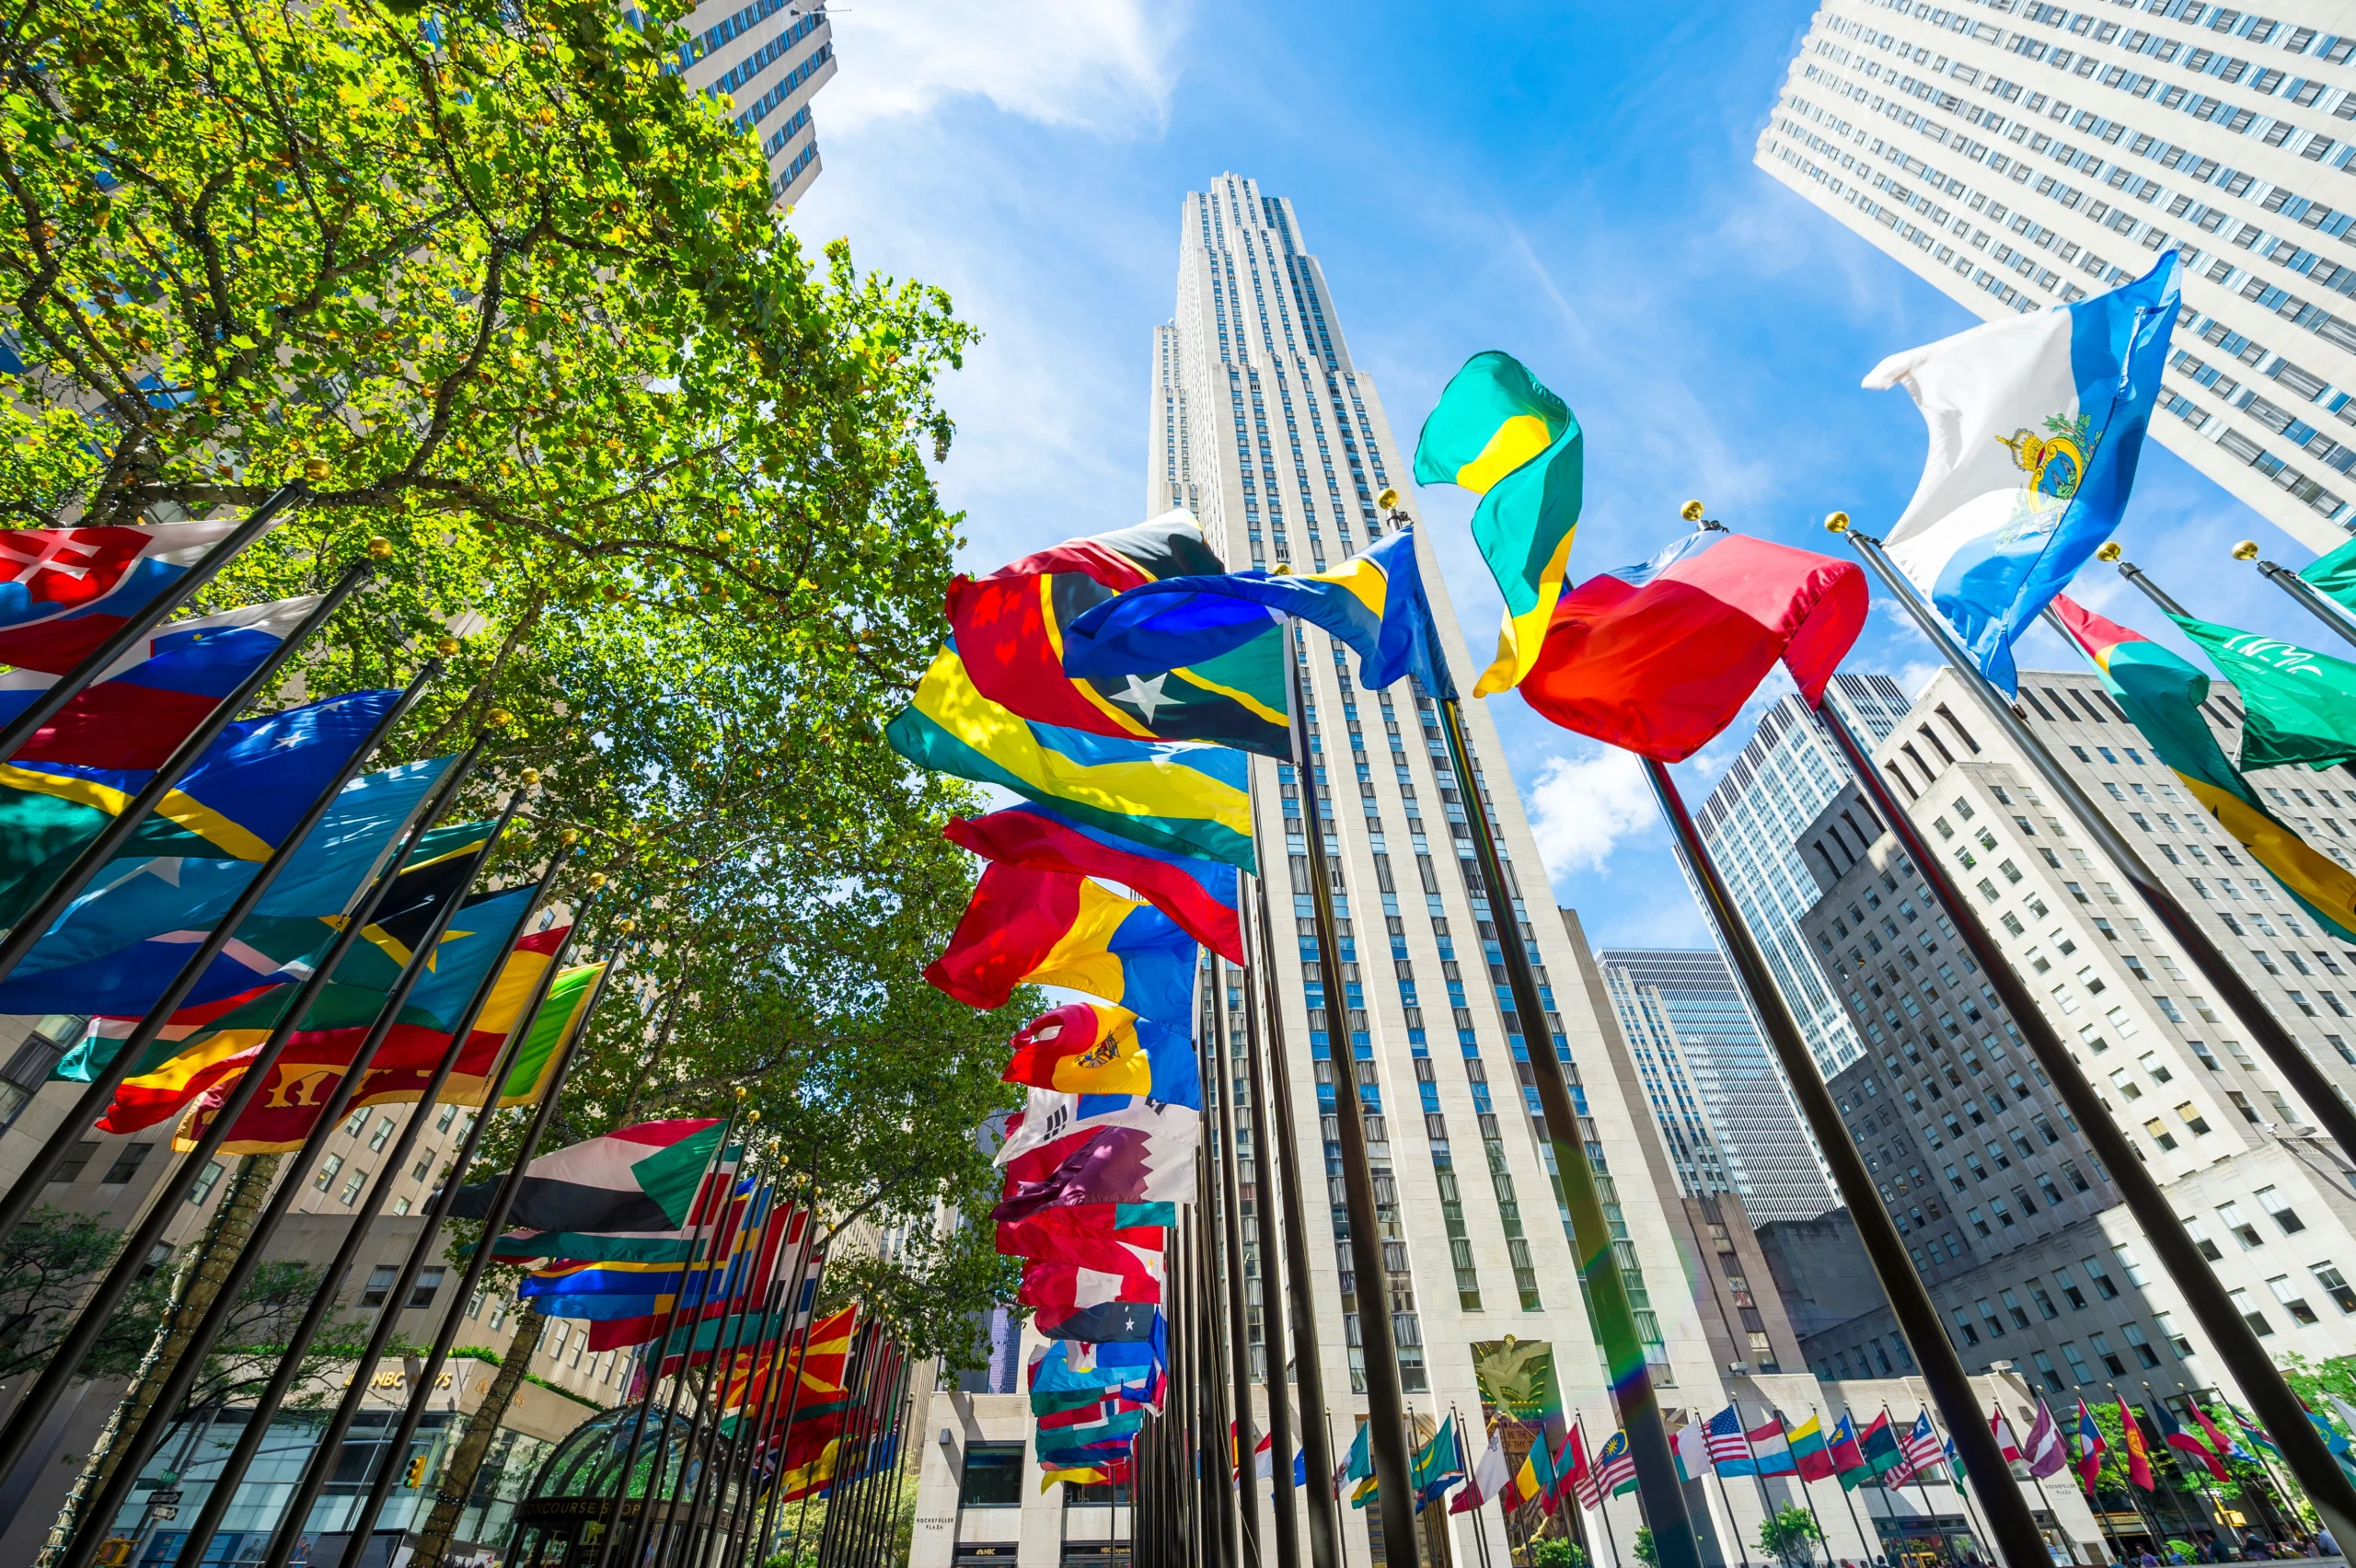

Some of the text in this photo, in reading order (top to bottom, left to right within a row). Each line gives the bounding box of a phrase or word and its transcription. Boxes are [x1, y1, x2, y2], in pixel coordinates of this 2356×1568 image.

[371, 1371, 405, 1388] NBC
[1517, 1430, 1527, 1438] THE
[521, 1502, 641, 1516] CONCOURSE SOP
